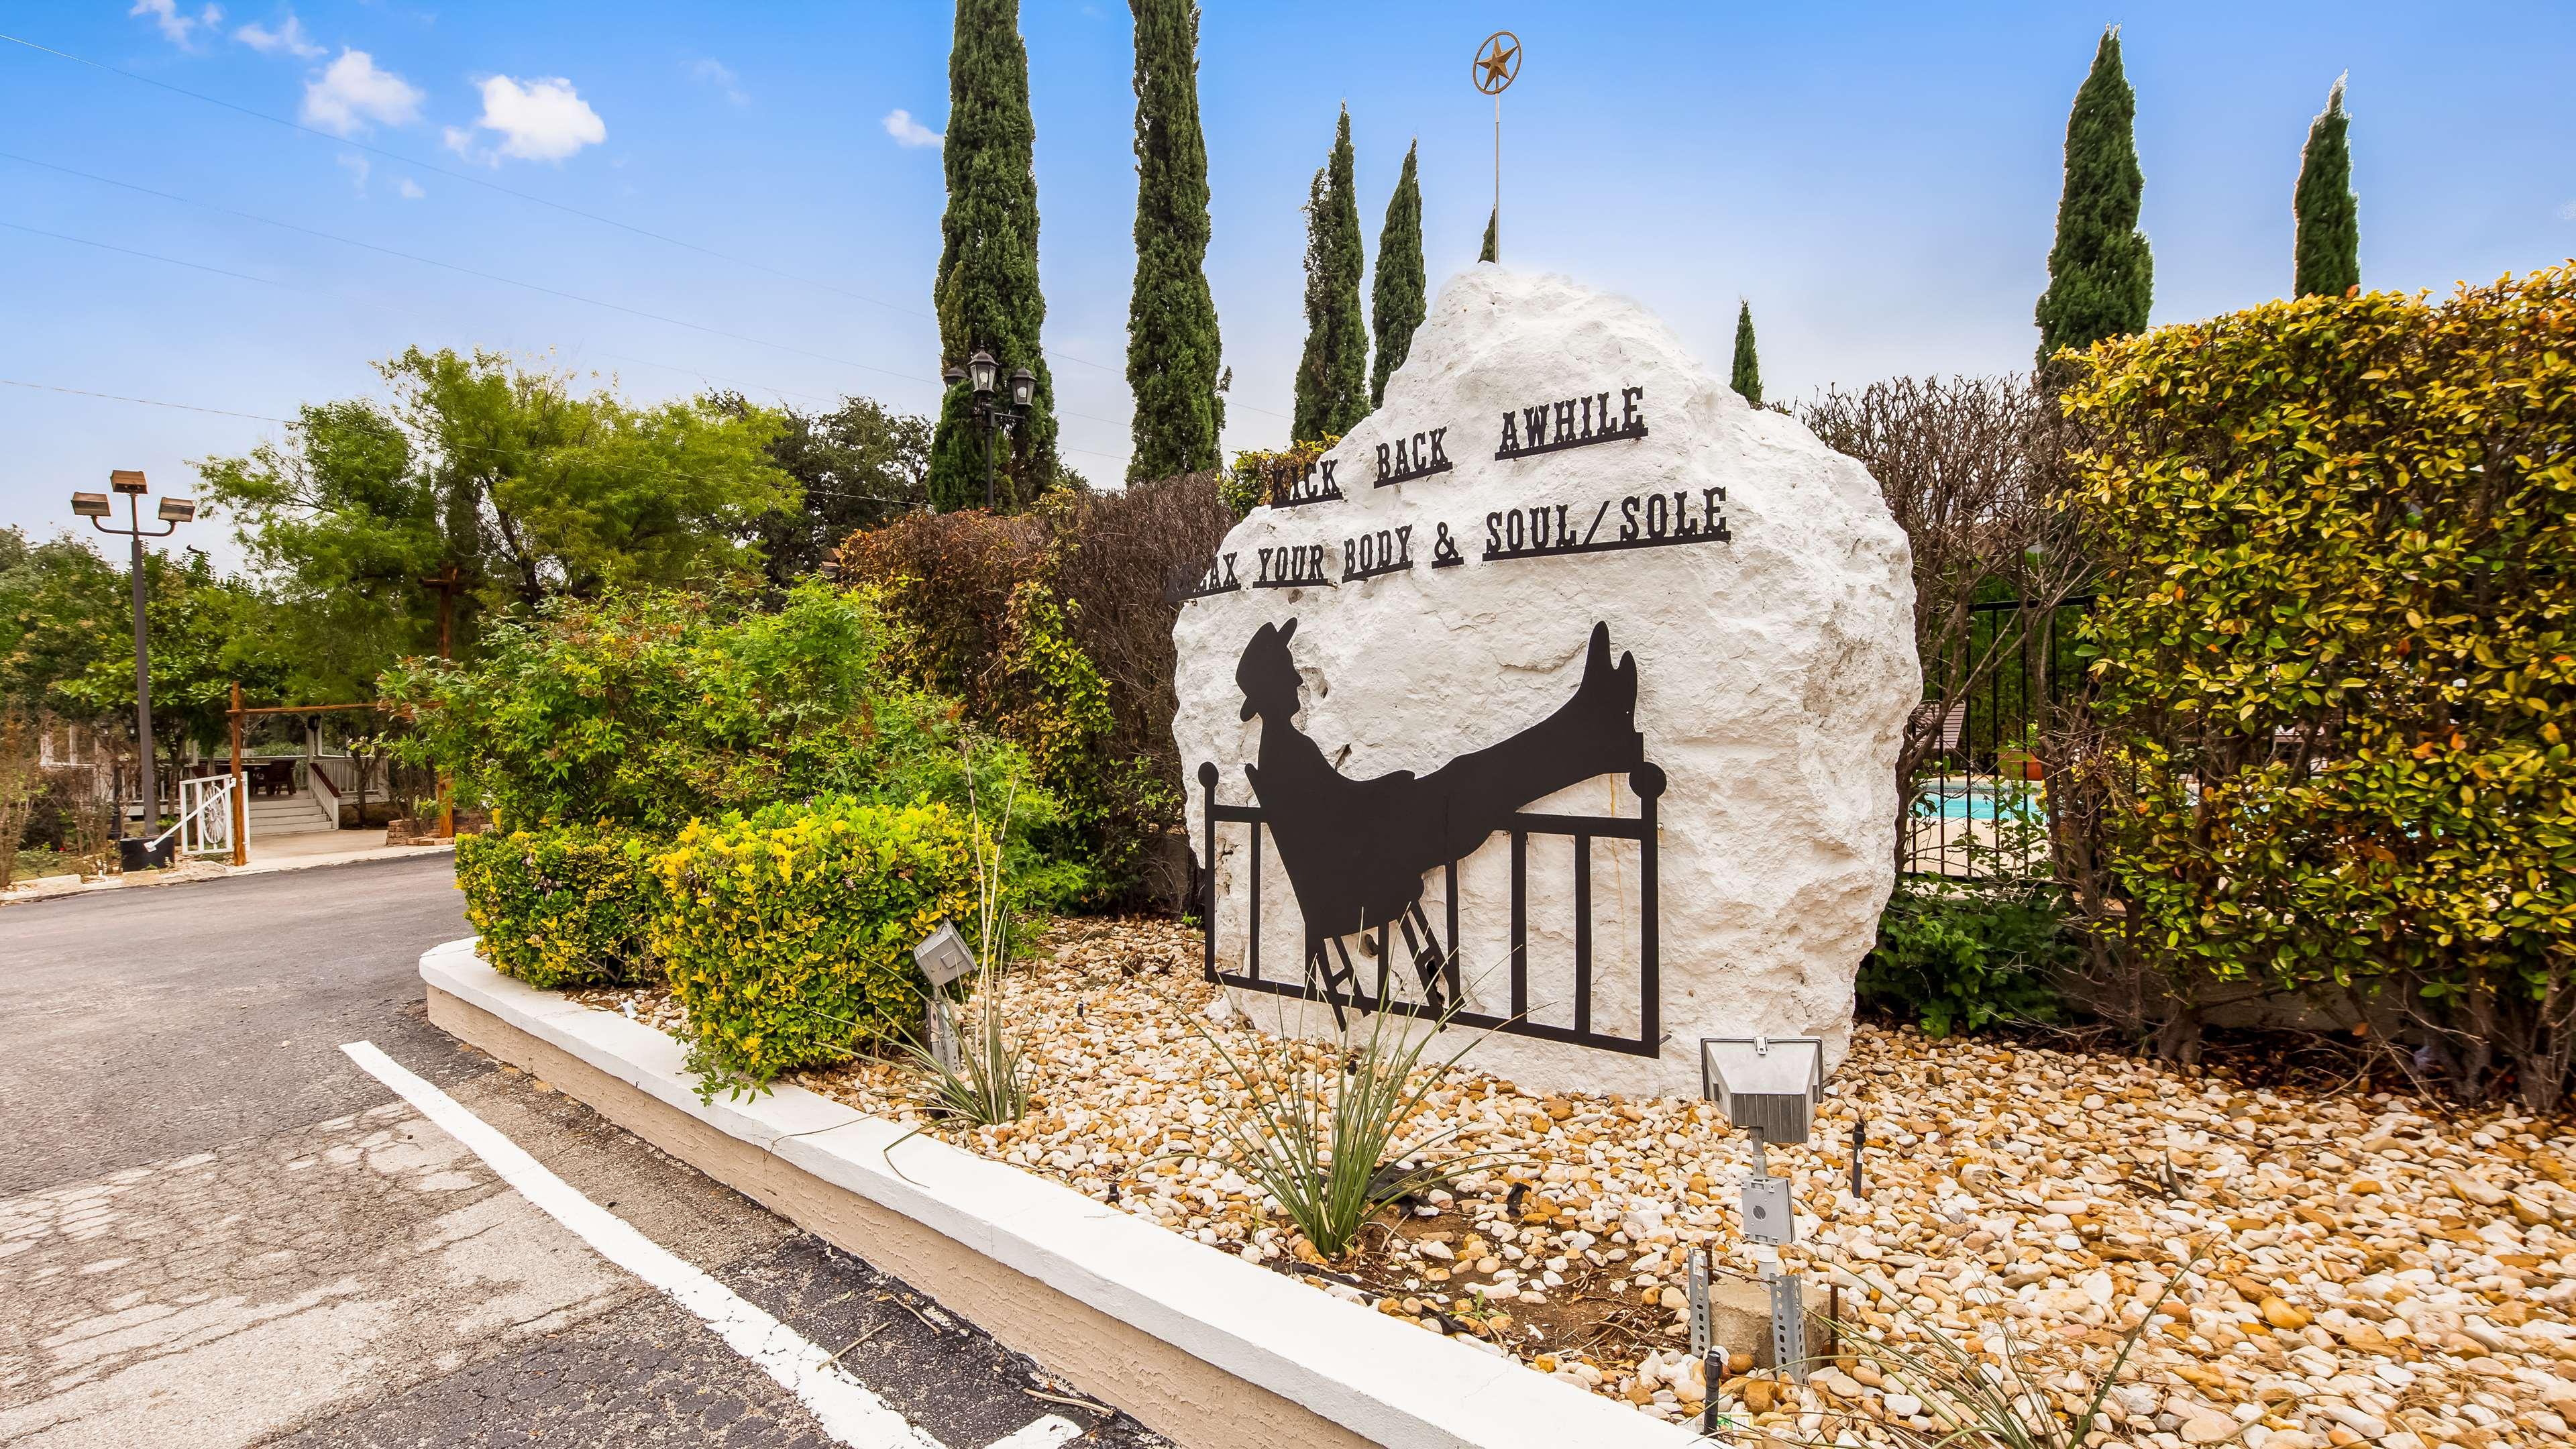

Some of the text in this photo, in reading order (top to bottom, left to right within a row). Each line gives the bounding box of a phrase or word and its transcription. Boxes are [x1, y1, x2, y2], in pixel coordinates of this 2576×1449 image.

[1273, 386, 1646, 503] KICK BACK AWHILE
[1166, 486, 1727, 594] LAX YOUR BODY & SOUL/SOLE
